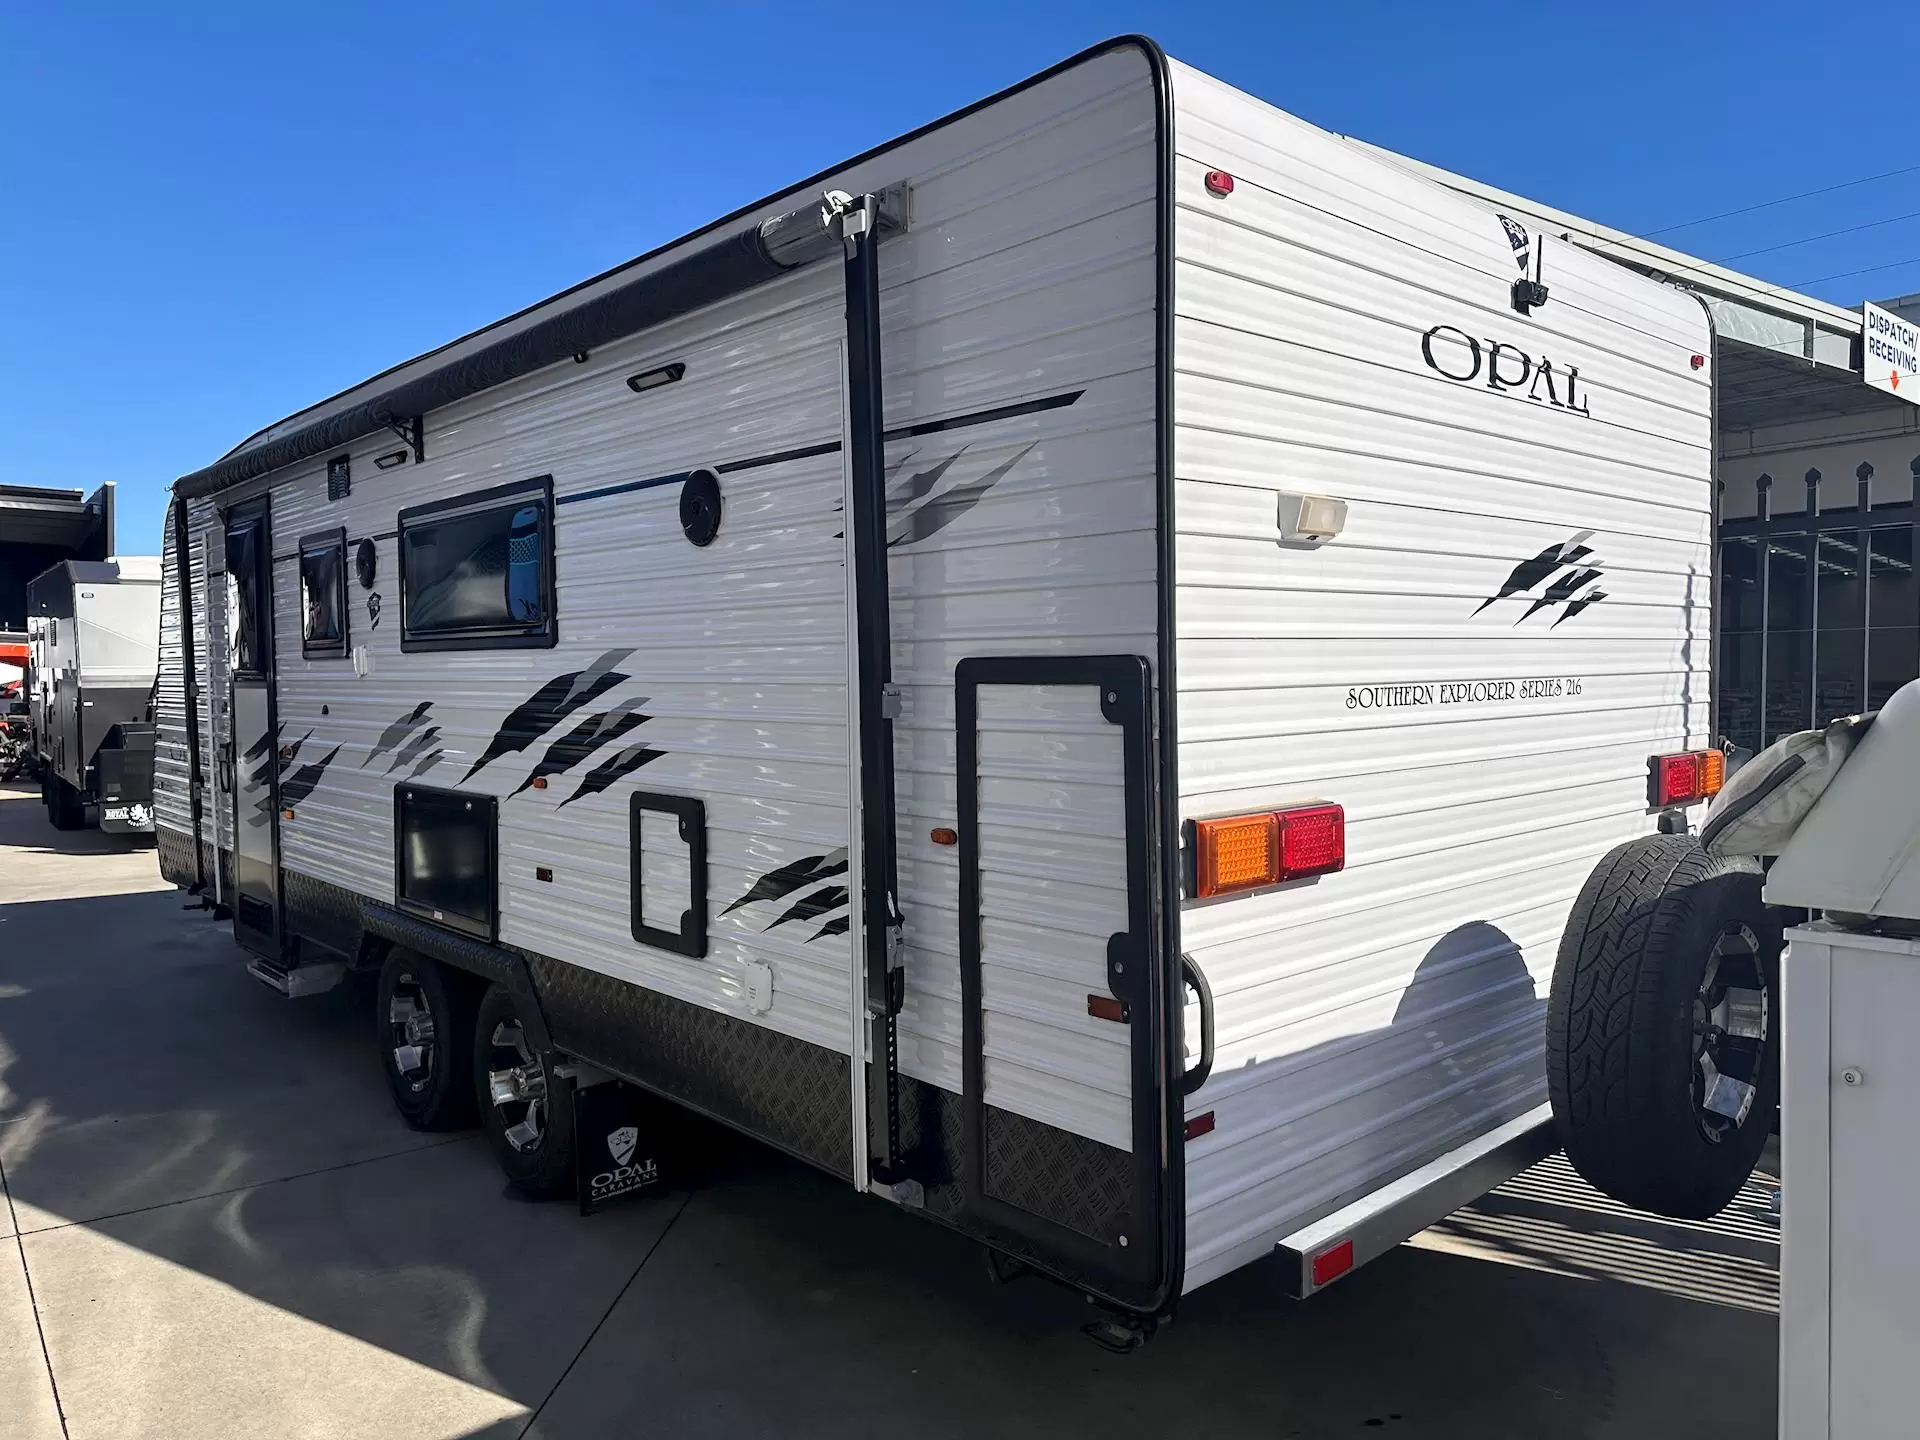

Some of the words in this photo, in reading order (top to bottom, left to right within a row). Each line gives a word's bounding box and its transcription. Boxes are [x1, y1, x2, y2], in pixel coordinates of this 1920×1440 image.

[1868, 310, 1919, 353] DISPATCH/
[1868, 335, 1918, 374] RECEIVING
[1421, 325, 1590, 418] OPAL
[1345, 685, 1434, 709] SOUTHERN
[1439, 681, 1515, 704] EXPLORER
[1519, 678, 1562, 699] SERIES
[1566, 678, 1582, 696] 216
[105, 809, 130, 820] ROYAL
[591, 1159, 657, 1188] OPAL
[592, 1171, 658, 1197] CARAVANS
